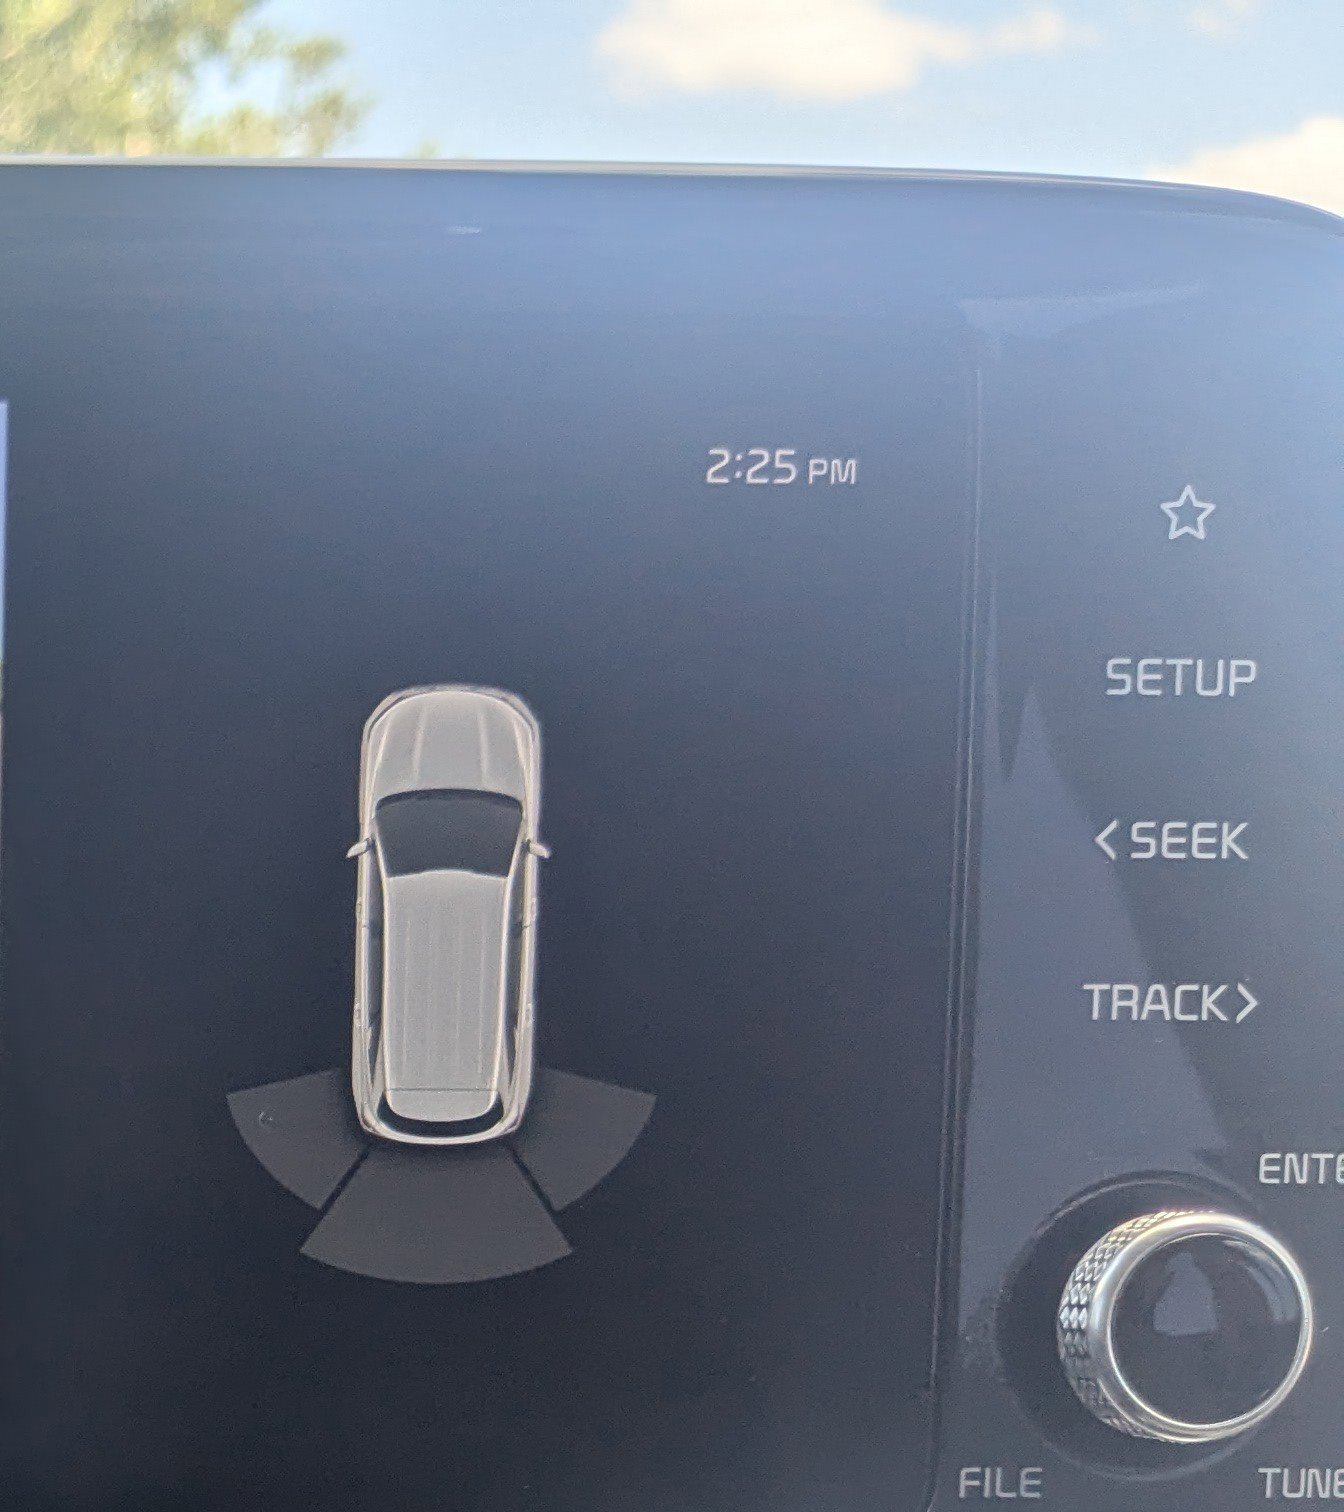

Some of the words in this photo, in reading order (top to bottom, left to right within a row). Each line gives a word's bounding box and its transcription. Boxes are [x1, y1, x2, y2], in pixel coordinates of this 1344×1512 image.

[706, 448, 798, 485] 2:25
[808, 457, 858, 485] PM
[1106, 658, 1258, 697] SETUP
[1130, 821, 1249, 860] SEEK
[1082, 983, 1229, 1022] TRACK
[958, 1466, 1043, 1499] FILE
